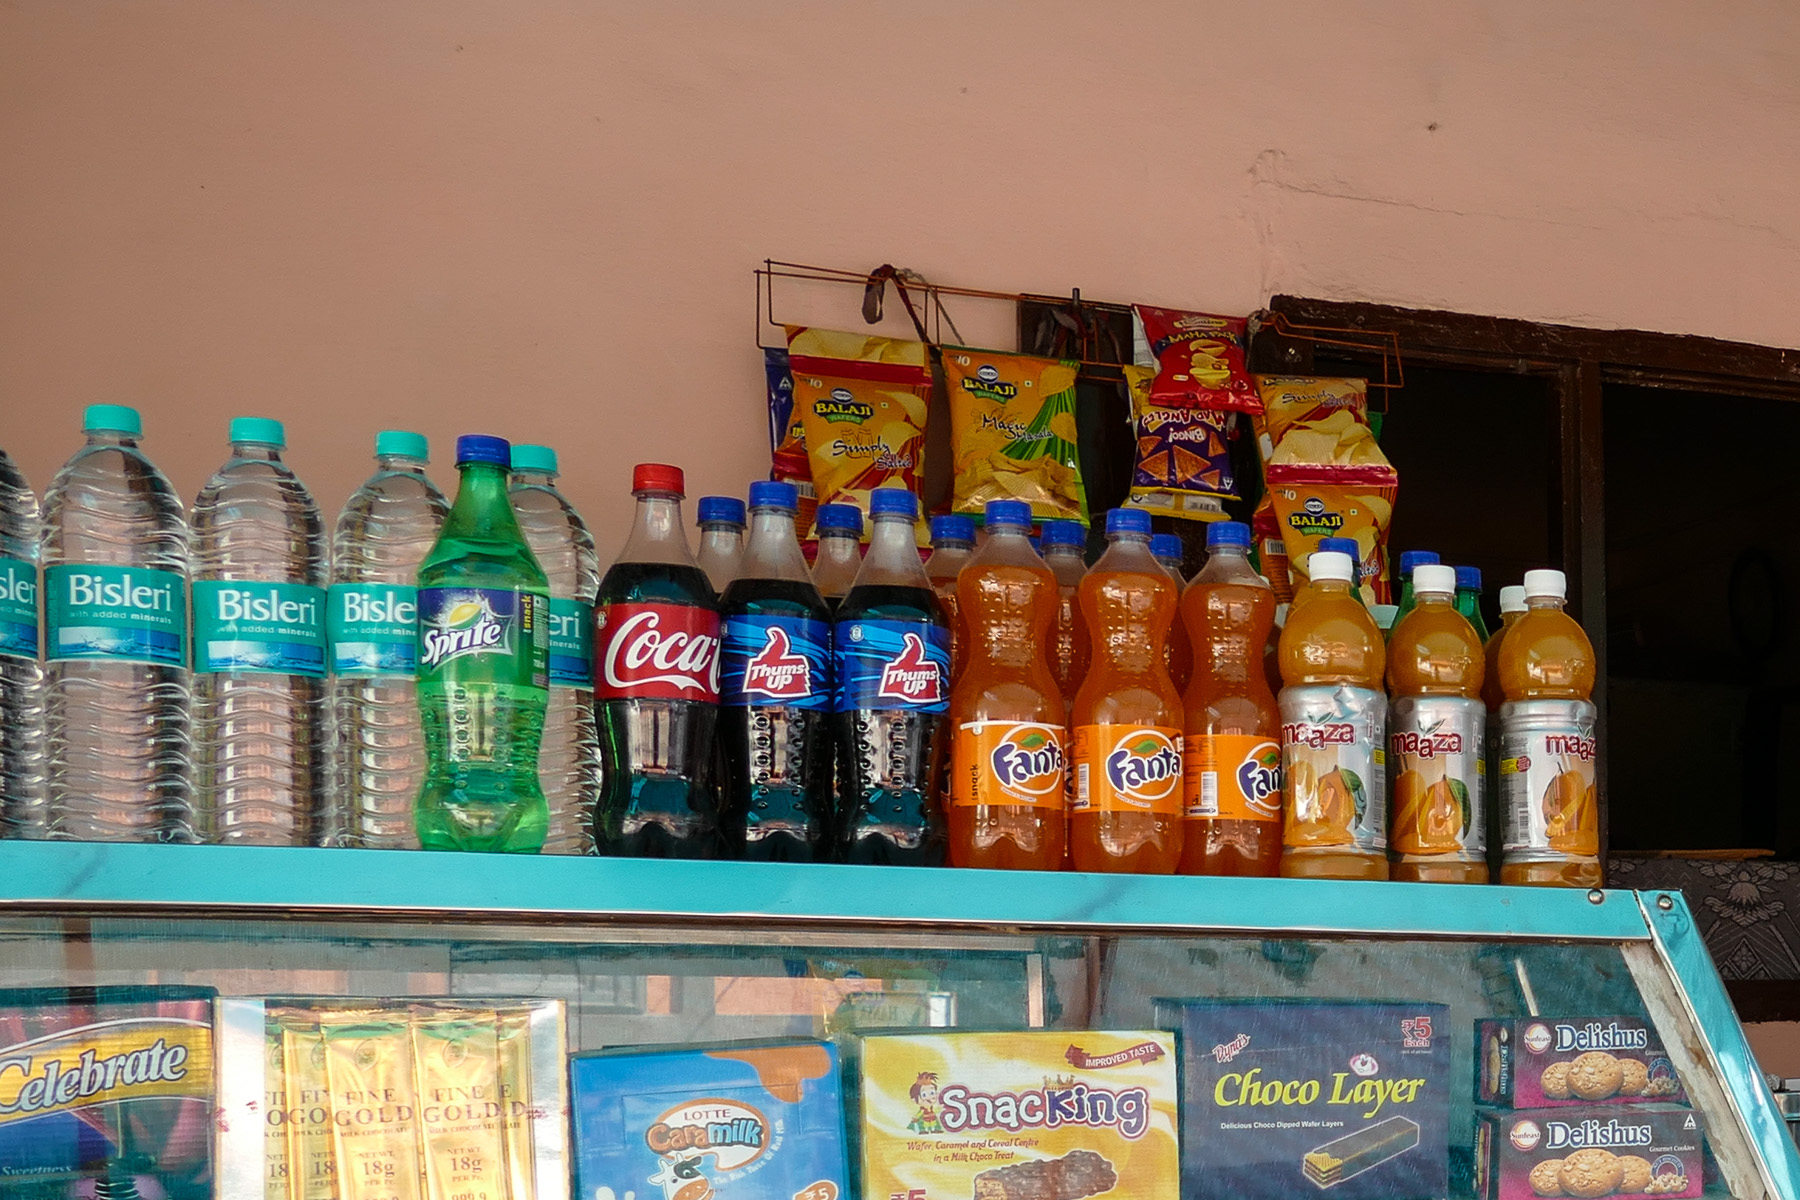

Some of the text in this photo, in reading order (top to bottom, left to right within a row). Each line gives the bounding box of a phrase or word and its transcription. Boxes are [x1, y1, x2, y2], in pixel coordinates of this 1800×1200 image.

[963, 377, 1015, 396] BALAJI
[815, 402, 872, 417] BALAJI
[832, 435, 891, 457] Simply
[1290, 514, 1343, 528] BALAJI
[68, 573, 172, 611] Bisleri
[217, 589, 317, 626] Bisleri
[92, 611, 173, 625] added minerals
[240, 625, 317, 638] added minerals
[420, 611, 502, 669] Sprite
[750, 663, 807, 682] Thums
[887, 667, 937, 685] Thums
[1281, 721, 1355, 750] maaza
[1391, 731, 1463, 759] maaza
[992, 740, 1065, 788] Fanta
[1106, 746, 1183, 794] Fanta
[1403, 1038, 1431, 1048] Each
[1555, 1022, 1648, 1052] Delishus
[1085, 1043, 1156, 1068] IMPROVED TASTE
[0, 1037, 189, 1114] Celebrate
[347, 1088, 395, 1104] FINE
[435, 1085, 484, 1102] FINE
[1214, 1067, 1426, 1119] Choco Layer
[334, 1105, 413, 1126] GOLD
[423, 1100, 502, 1123] GOLD
[684, 1108, 732, 1122] LOTTE
[1220, 1120, 1344, 1130] Delicious Choco Dipped Wafer Layers
[1546, 1119, 1653, 1149] Delishus
[647, 1118, 764, 1155] Caramilk
[935, 1139, 970, 1153] Caramel
[971, 1139, 987, 1151] and
[988, 1138, 1013, 1148] Cereal
[1014, 1137, 1040, 1147] Centre
[1509, 1130, 1542, 1141] Sunfeast
[933, 1153, 942, 1164] in
[950, 1151, 968, 1163] Milk
[969, 1150, 993, 1163] Choco
[994, 1150, 1015, 1160] Treat
[1649, 1144, 1696, 1153] Gourmet Cookies
[2, 1164, 72, 1177] Sweetness
[363, 1161, 394, 1178] 18g
[451, 1155, 483, 1172] 18g
